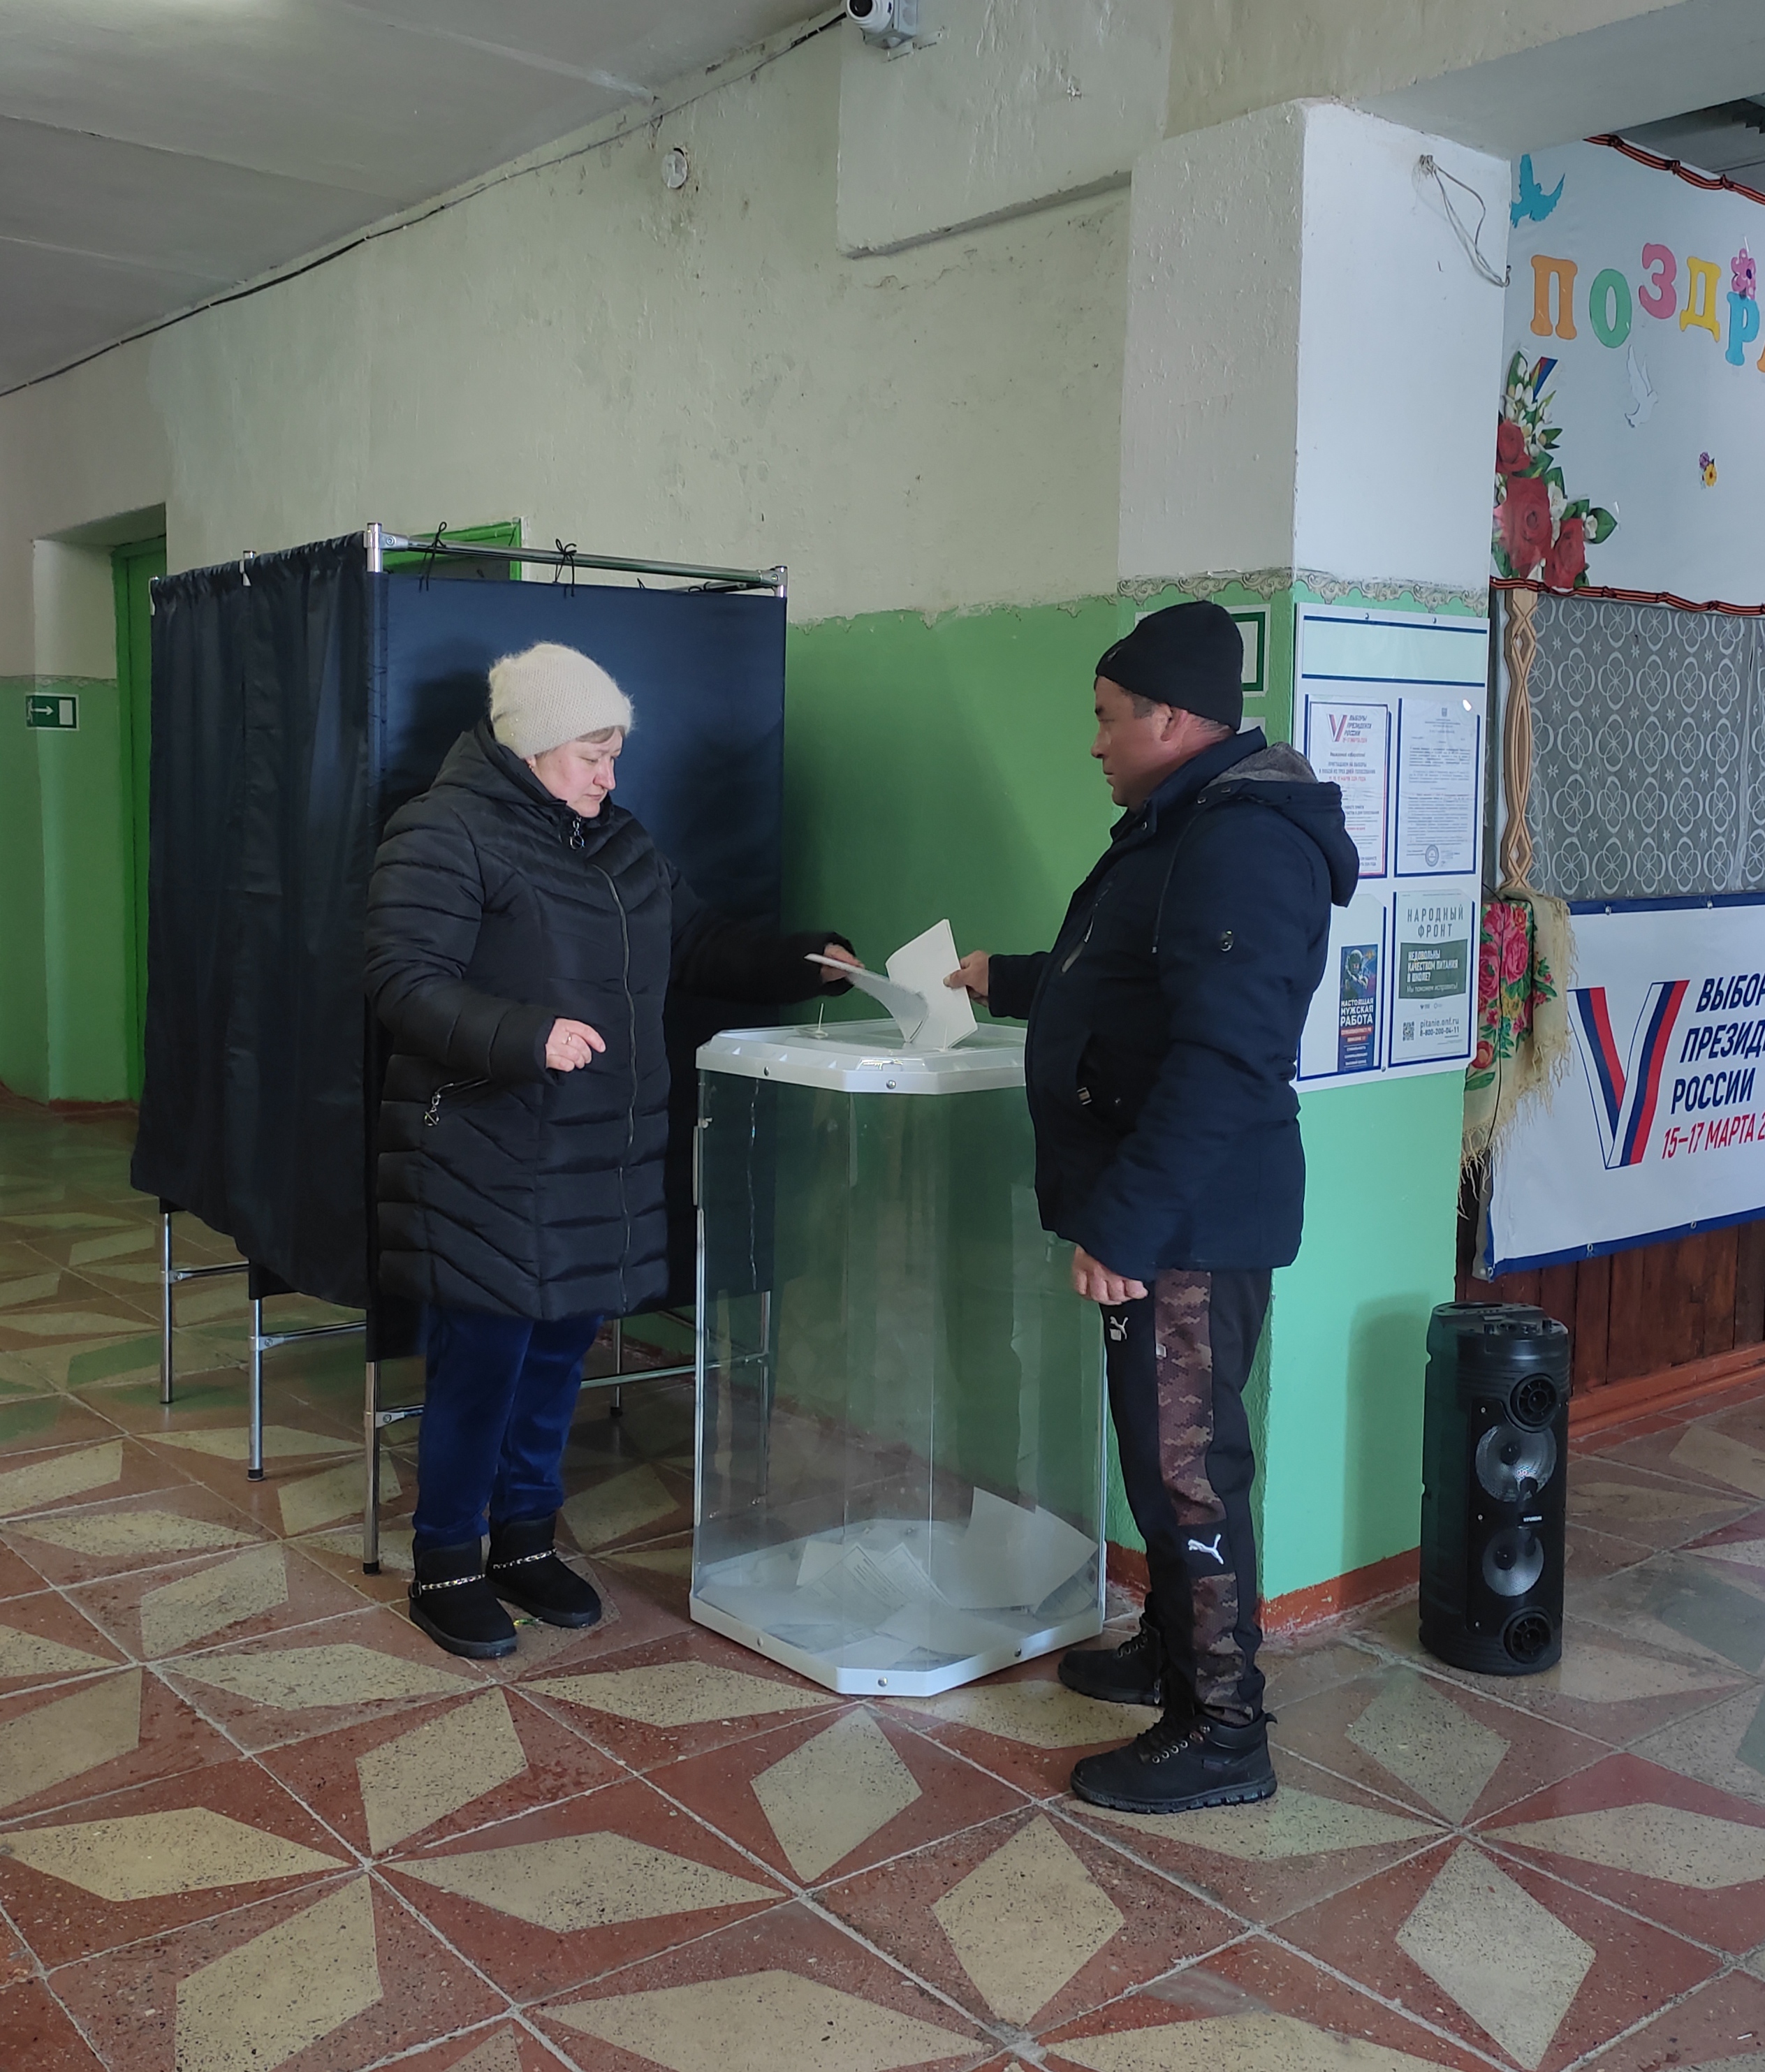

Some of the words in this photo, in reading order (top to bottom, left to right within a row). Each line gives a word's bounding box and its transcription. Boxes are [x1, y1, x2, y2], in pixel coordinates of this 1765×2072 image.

[1530, 243, 1765, 372] ПОЗДР
[1407, 905, 1463, 923] НАРОДНЫЙ
[1418, 923, 1453, 939] ФРОНТ
[1408, 950, 1440, 961] НЕДОВОЛЬНЫ
[1407, 961, 1435, 971] КАЧЕСТВОМ
[1436, 959, 1458, 970] ПИТАНИЯ
[1407, 973, 1411, 983] В
[1412, 971, 1431, 982] ШКОЛЕ?
[1341, 998, 1374, 1006] НАСТОЯЩАЯ
[1341, 1005, 1374, 1015] МУЖСКАЯ
[1340, 1013, 1373, 1027] РАБОТА
[1421, 1017, 1459, 1029] pitanie.onf.ru
[1679, 1020, 1765, 1063] ПРЕЗИД
[1671, 1067, 1756, 1115] РОССИИ
[1704, 1112, 1756, 1152] МАРТА
